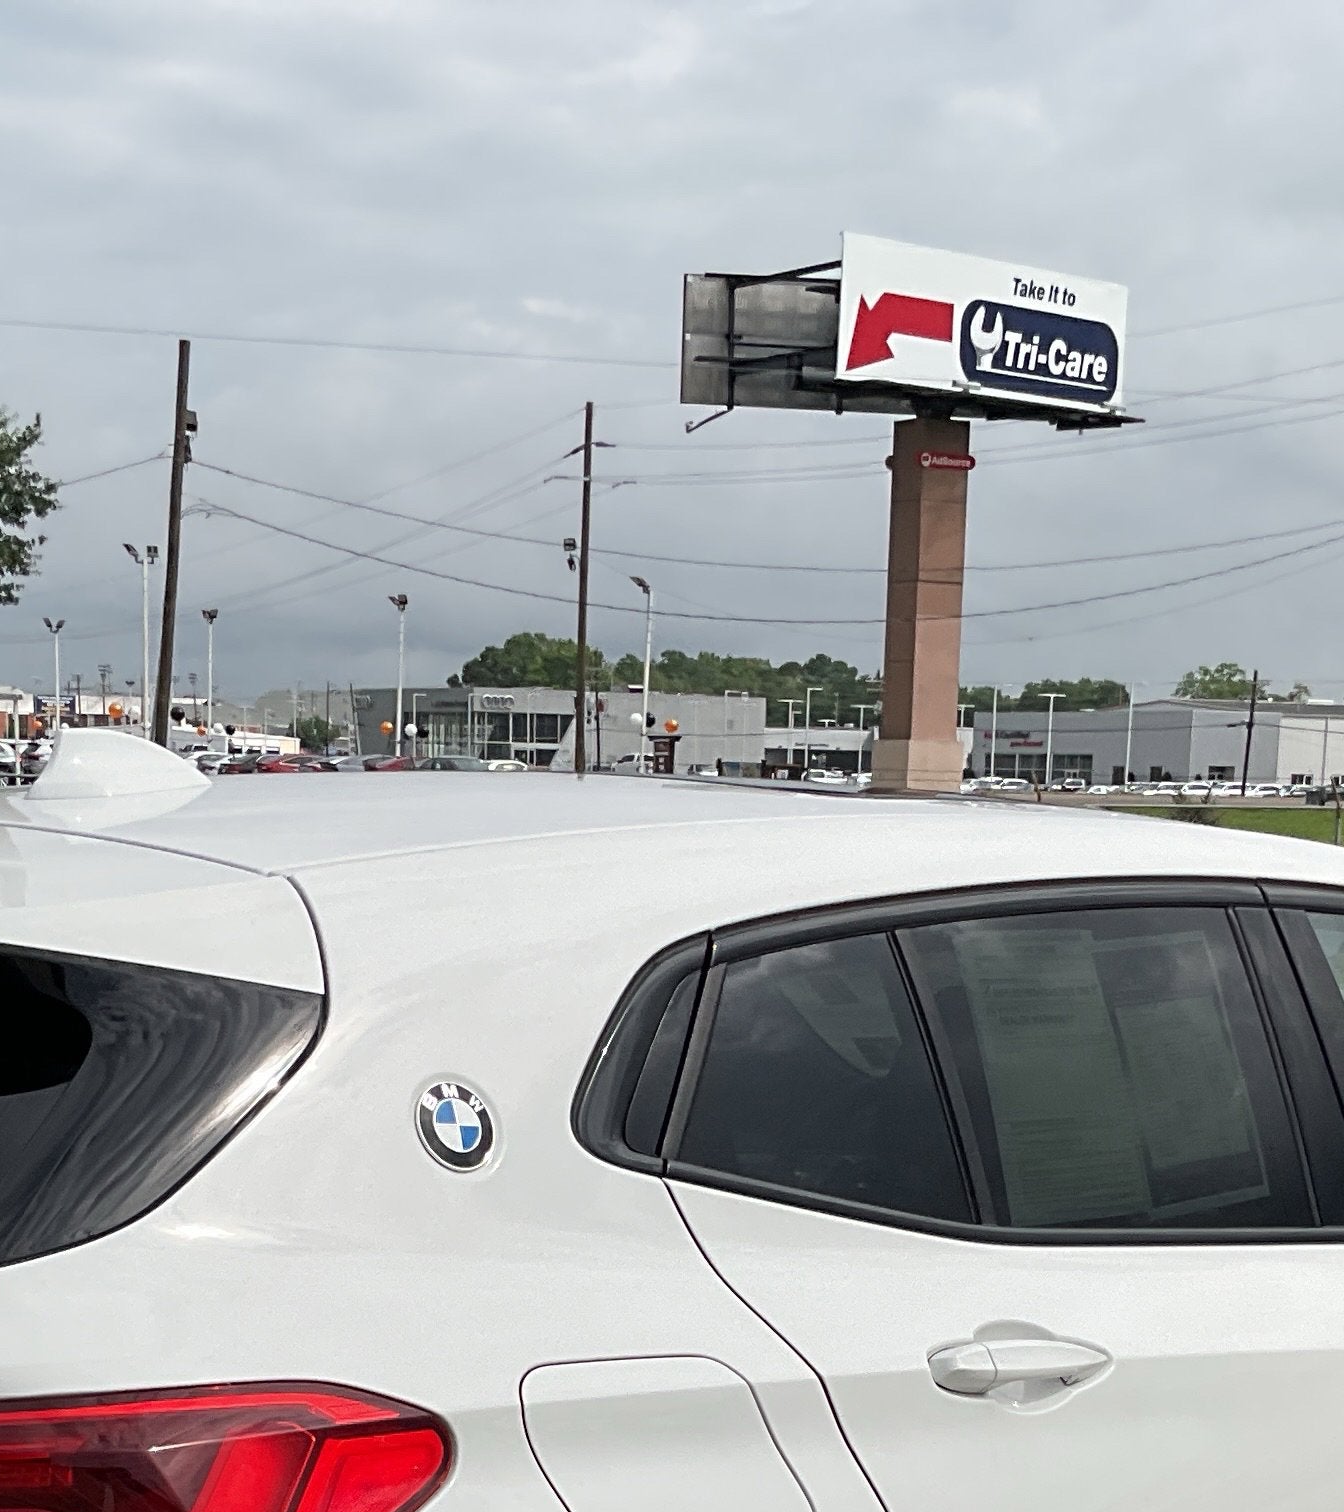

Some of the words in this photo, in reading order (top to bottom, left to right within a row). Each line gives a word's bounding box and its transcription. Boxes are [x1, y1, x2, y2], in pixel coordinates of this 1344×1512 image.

[1013, 277, 1045, 301] Take
[1047, 284, 1059, 304] It
[1061, 287, 1077, 307] to
[1003, 330, 1109, 383] Tri-Care
[420, 1082, 485, 1113] BMW
